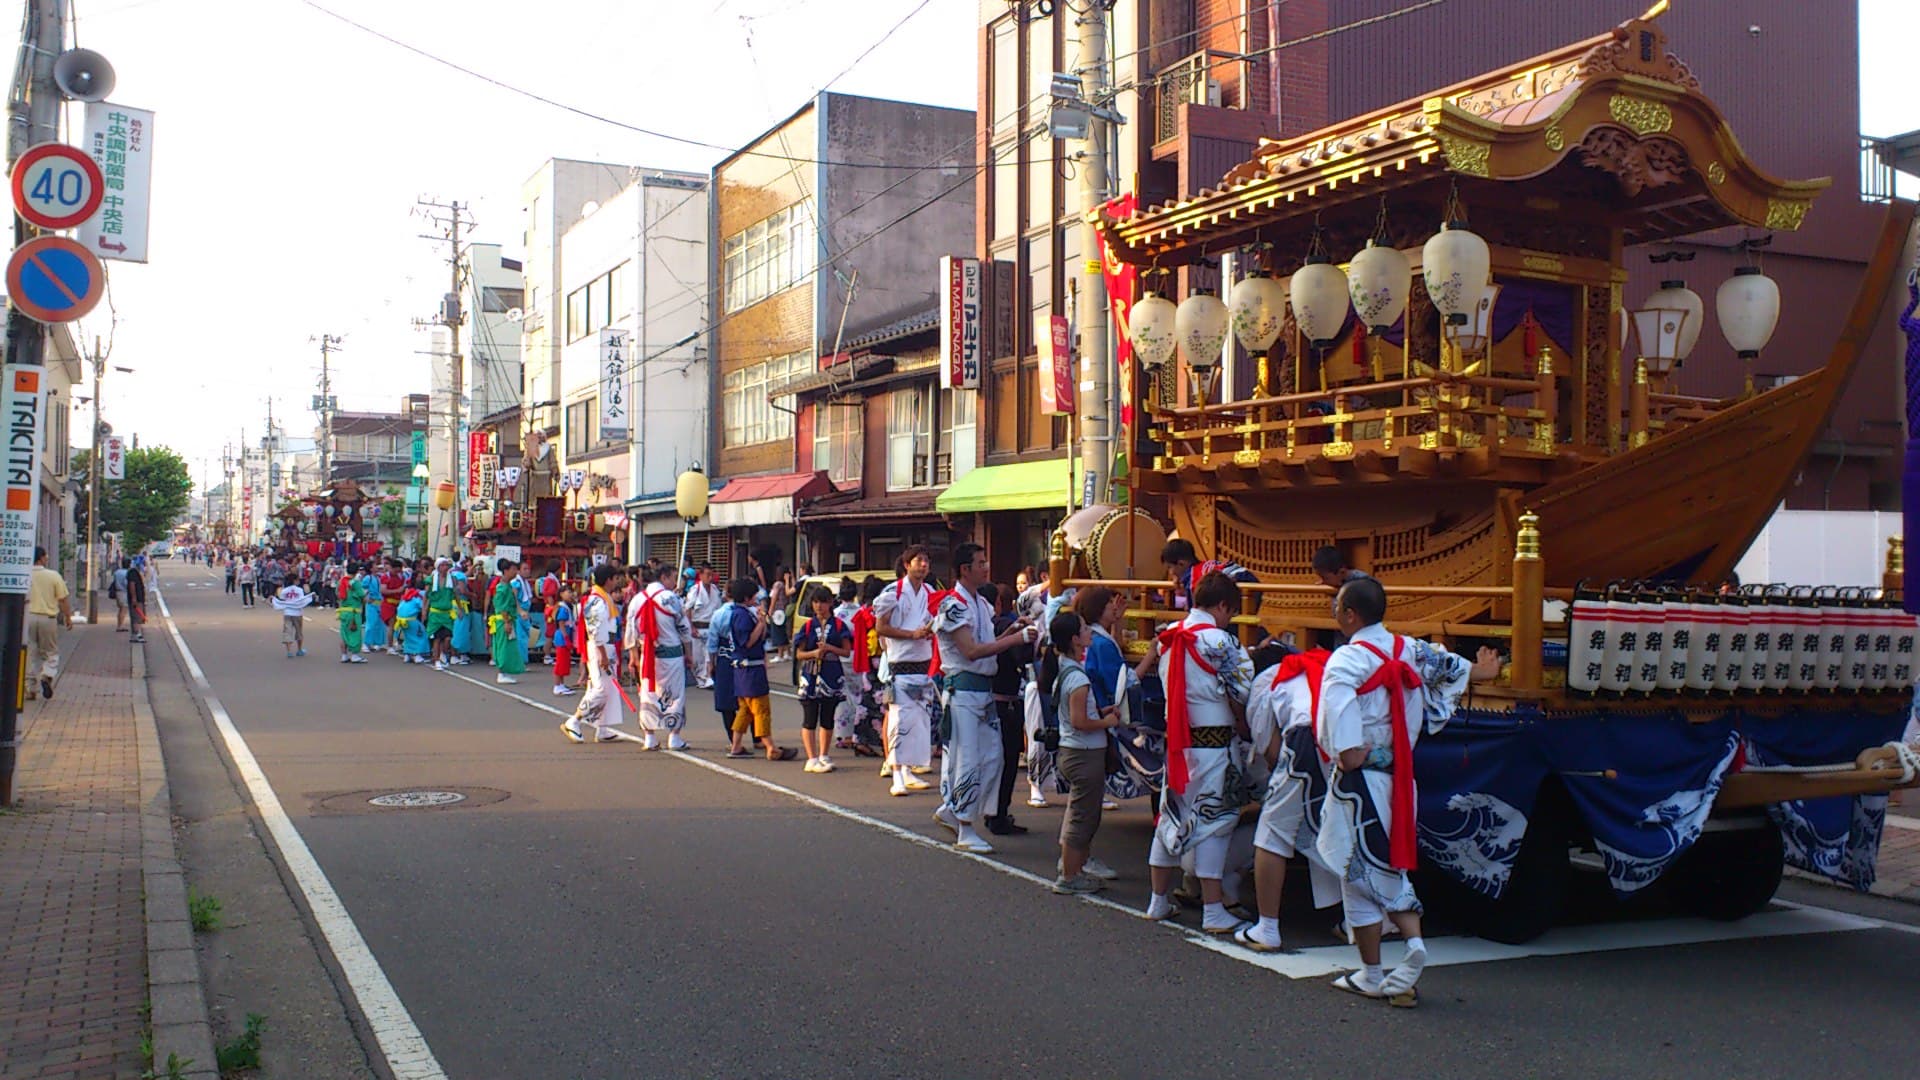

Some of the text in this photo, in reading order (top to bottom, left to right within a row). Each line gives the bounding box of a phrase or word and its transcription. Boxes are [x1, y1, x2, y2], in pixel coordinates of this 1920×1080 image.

[94, 132, 104, 168] 直江津小
[102, 111, 128, 235] 中央調剤薬局 中央店
[130, 118, 142, 152] 処方せん
[31, 167, 83, 206] 40
[952, 261, 961, 375] JEL MARUNAGA
[964, 265, 977, 380] ジェル マルナガ
[8, 397, 37, 485] TAKITA
